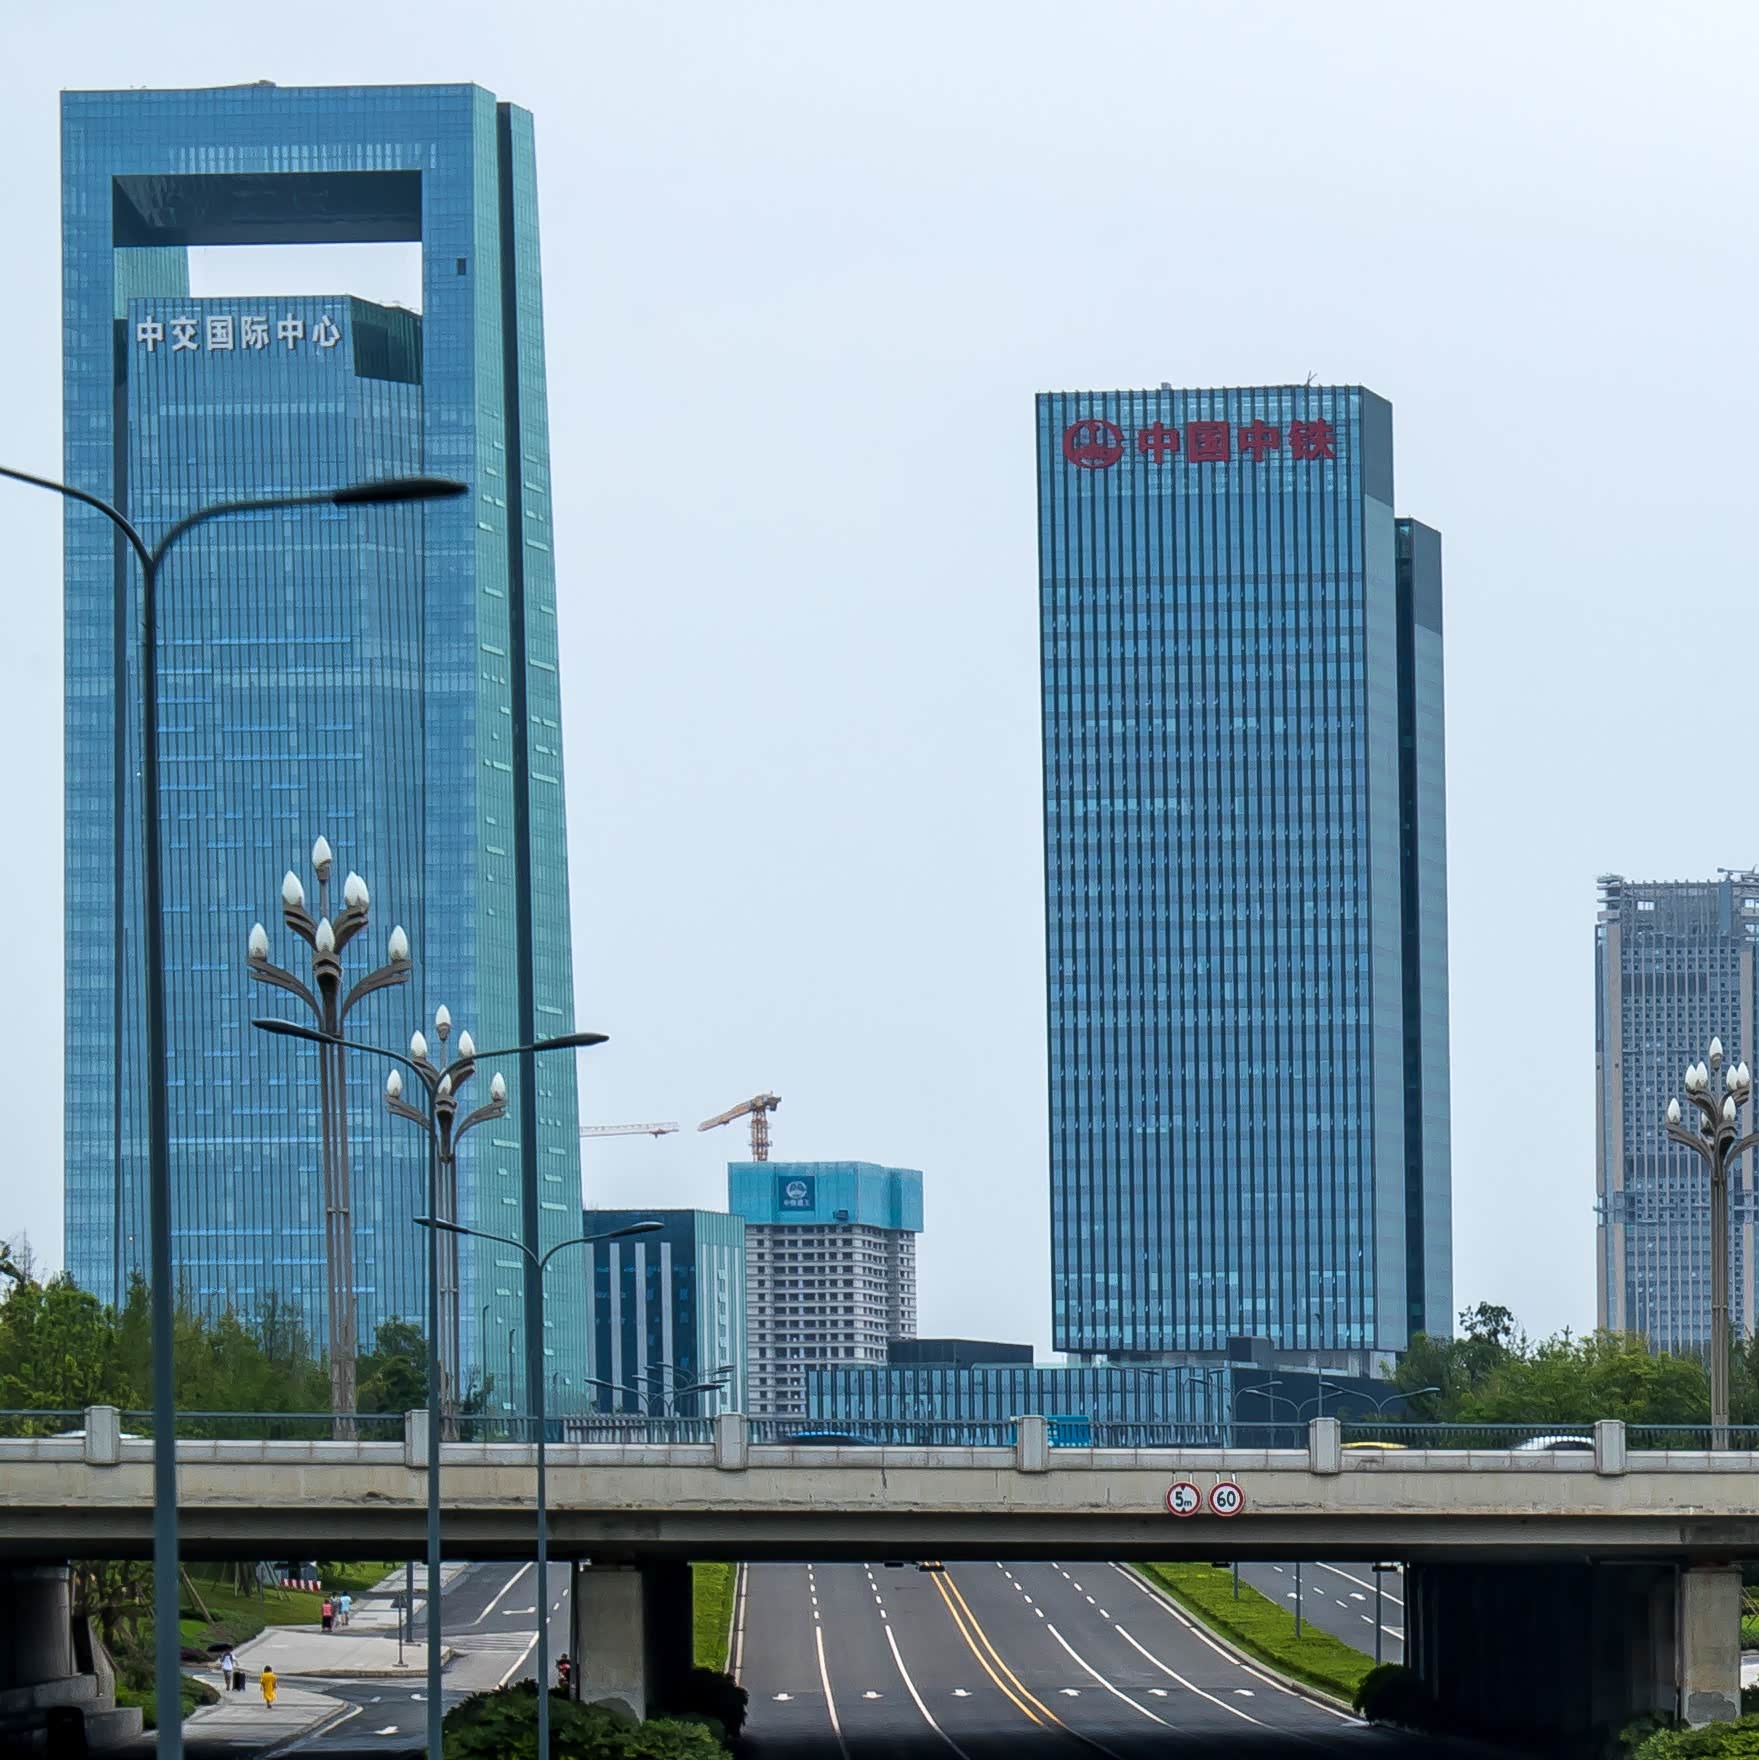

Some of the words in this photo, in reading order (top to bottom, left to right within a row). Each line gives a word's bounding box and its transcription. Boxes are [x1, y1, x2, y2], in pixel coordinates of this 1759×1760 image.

[136, 313, 341, 351] 中交国际中心
[1138, 418, 1336, 465] 中国中铁
[1216, 1491, 1236, 1507] 60
